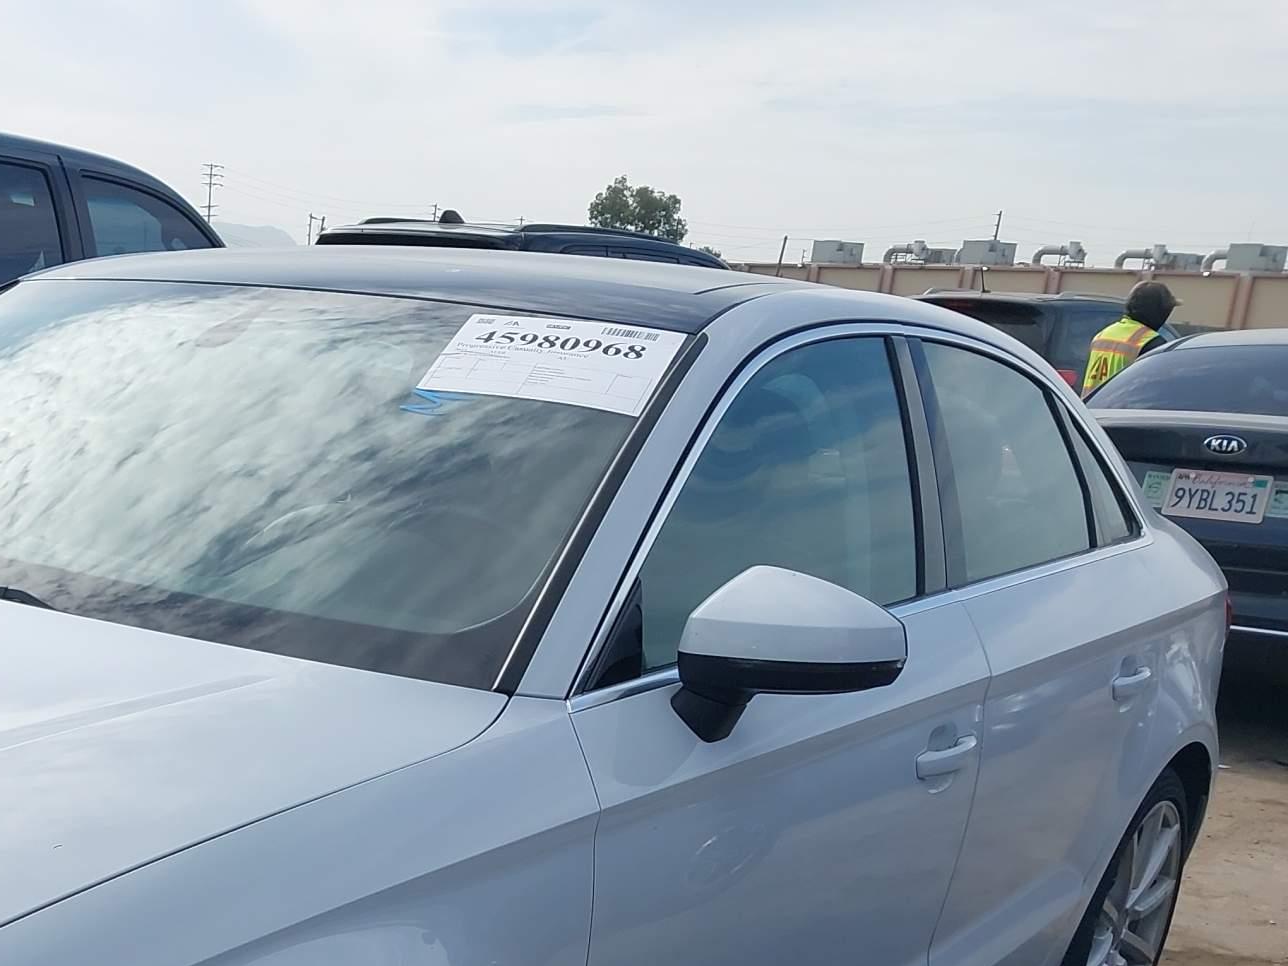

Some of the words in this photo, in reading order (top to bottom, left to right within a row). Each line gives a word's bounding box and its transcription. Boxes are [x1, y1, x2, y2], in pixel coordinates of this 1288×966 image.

[475, 330, 646, 360] 45980968
[1210, 439, 1239, 452] KIA
[1192, 473, 1249, 488] California
[1170, 487, 1259, 515] 9YBL351
